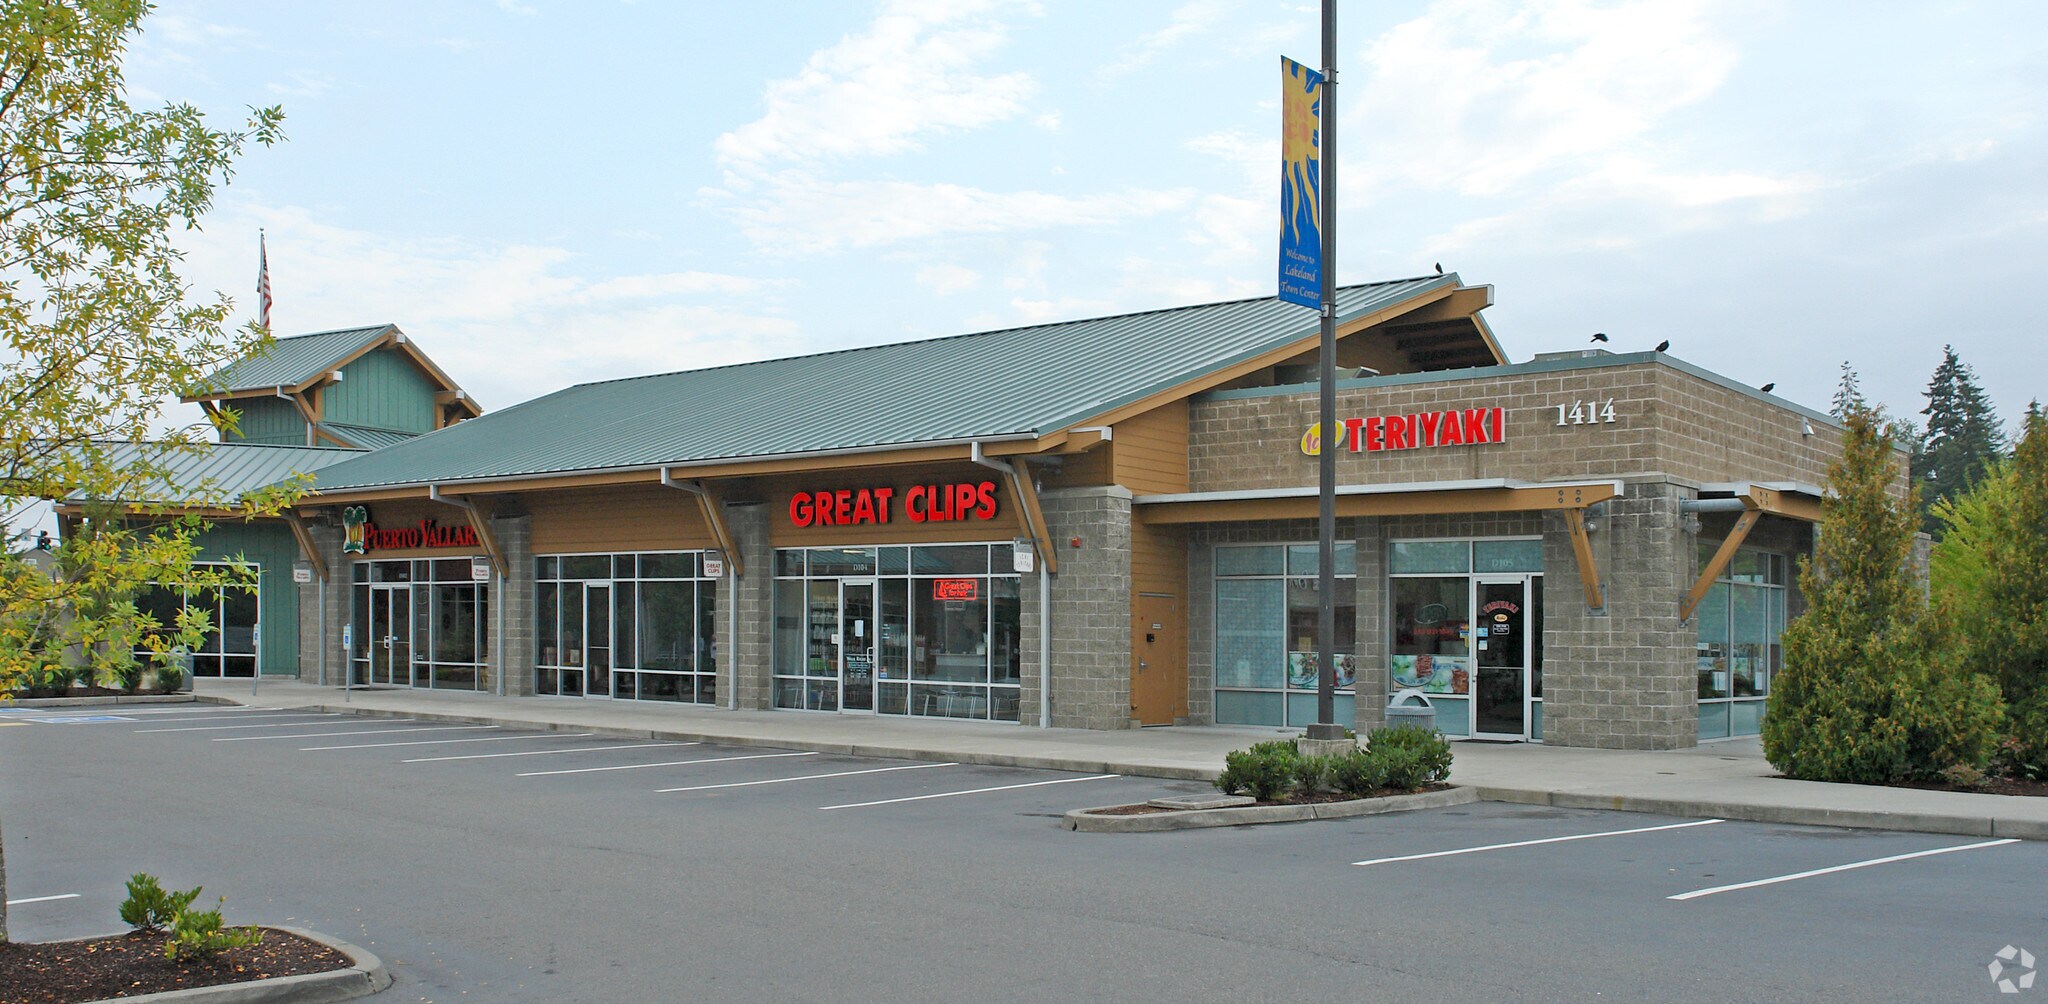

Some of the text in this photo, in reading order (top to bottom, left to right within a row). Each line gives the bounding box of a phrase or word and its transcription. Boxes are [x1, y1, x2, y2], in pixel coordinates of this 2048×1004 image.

[1286, 248, 1315, 265] Welcome to
[1284, 264, 1317, 282] Lakeland
[1280, 280, 1320, 300] Town Center
[1556, 398, 1616, 426] 1414
[1345, 407, 1505, 453] TERIYAKI
[789, 481, 996, 527] GREAT CLIPS
[364, 522, 418, 549] PUERTO
